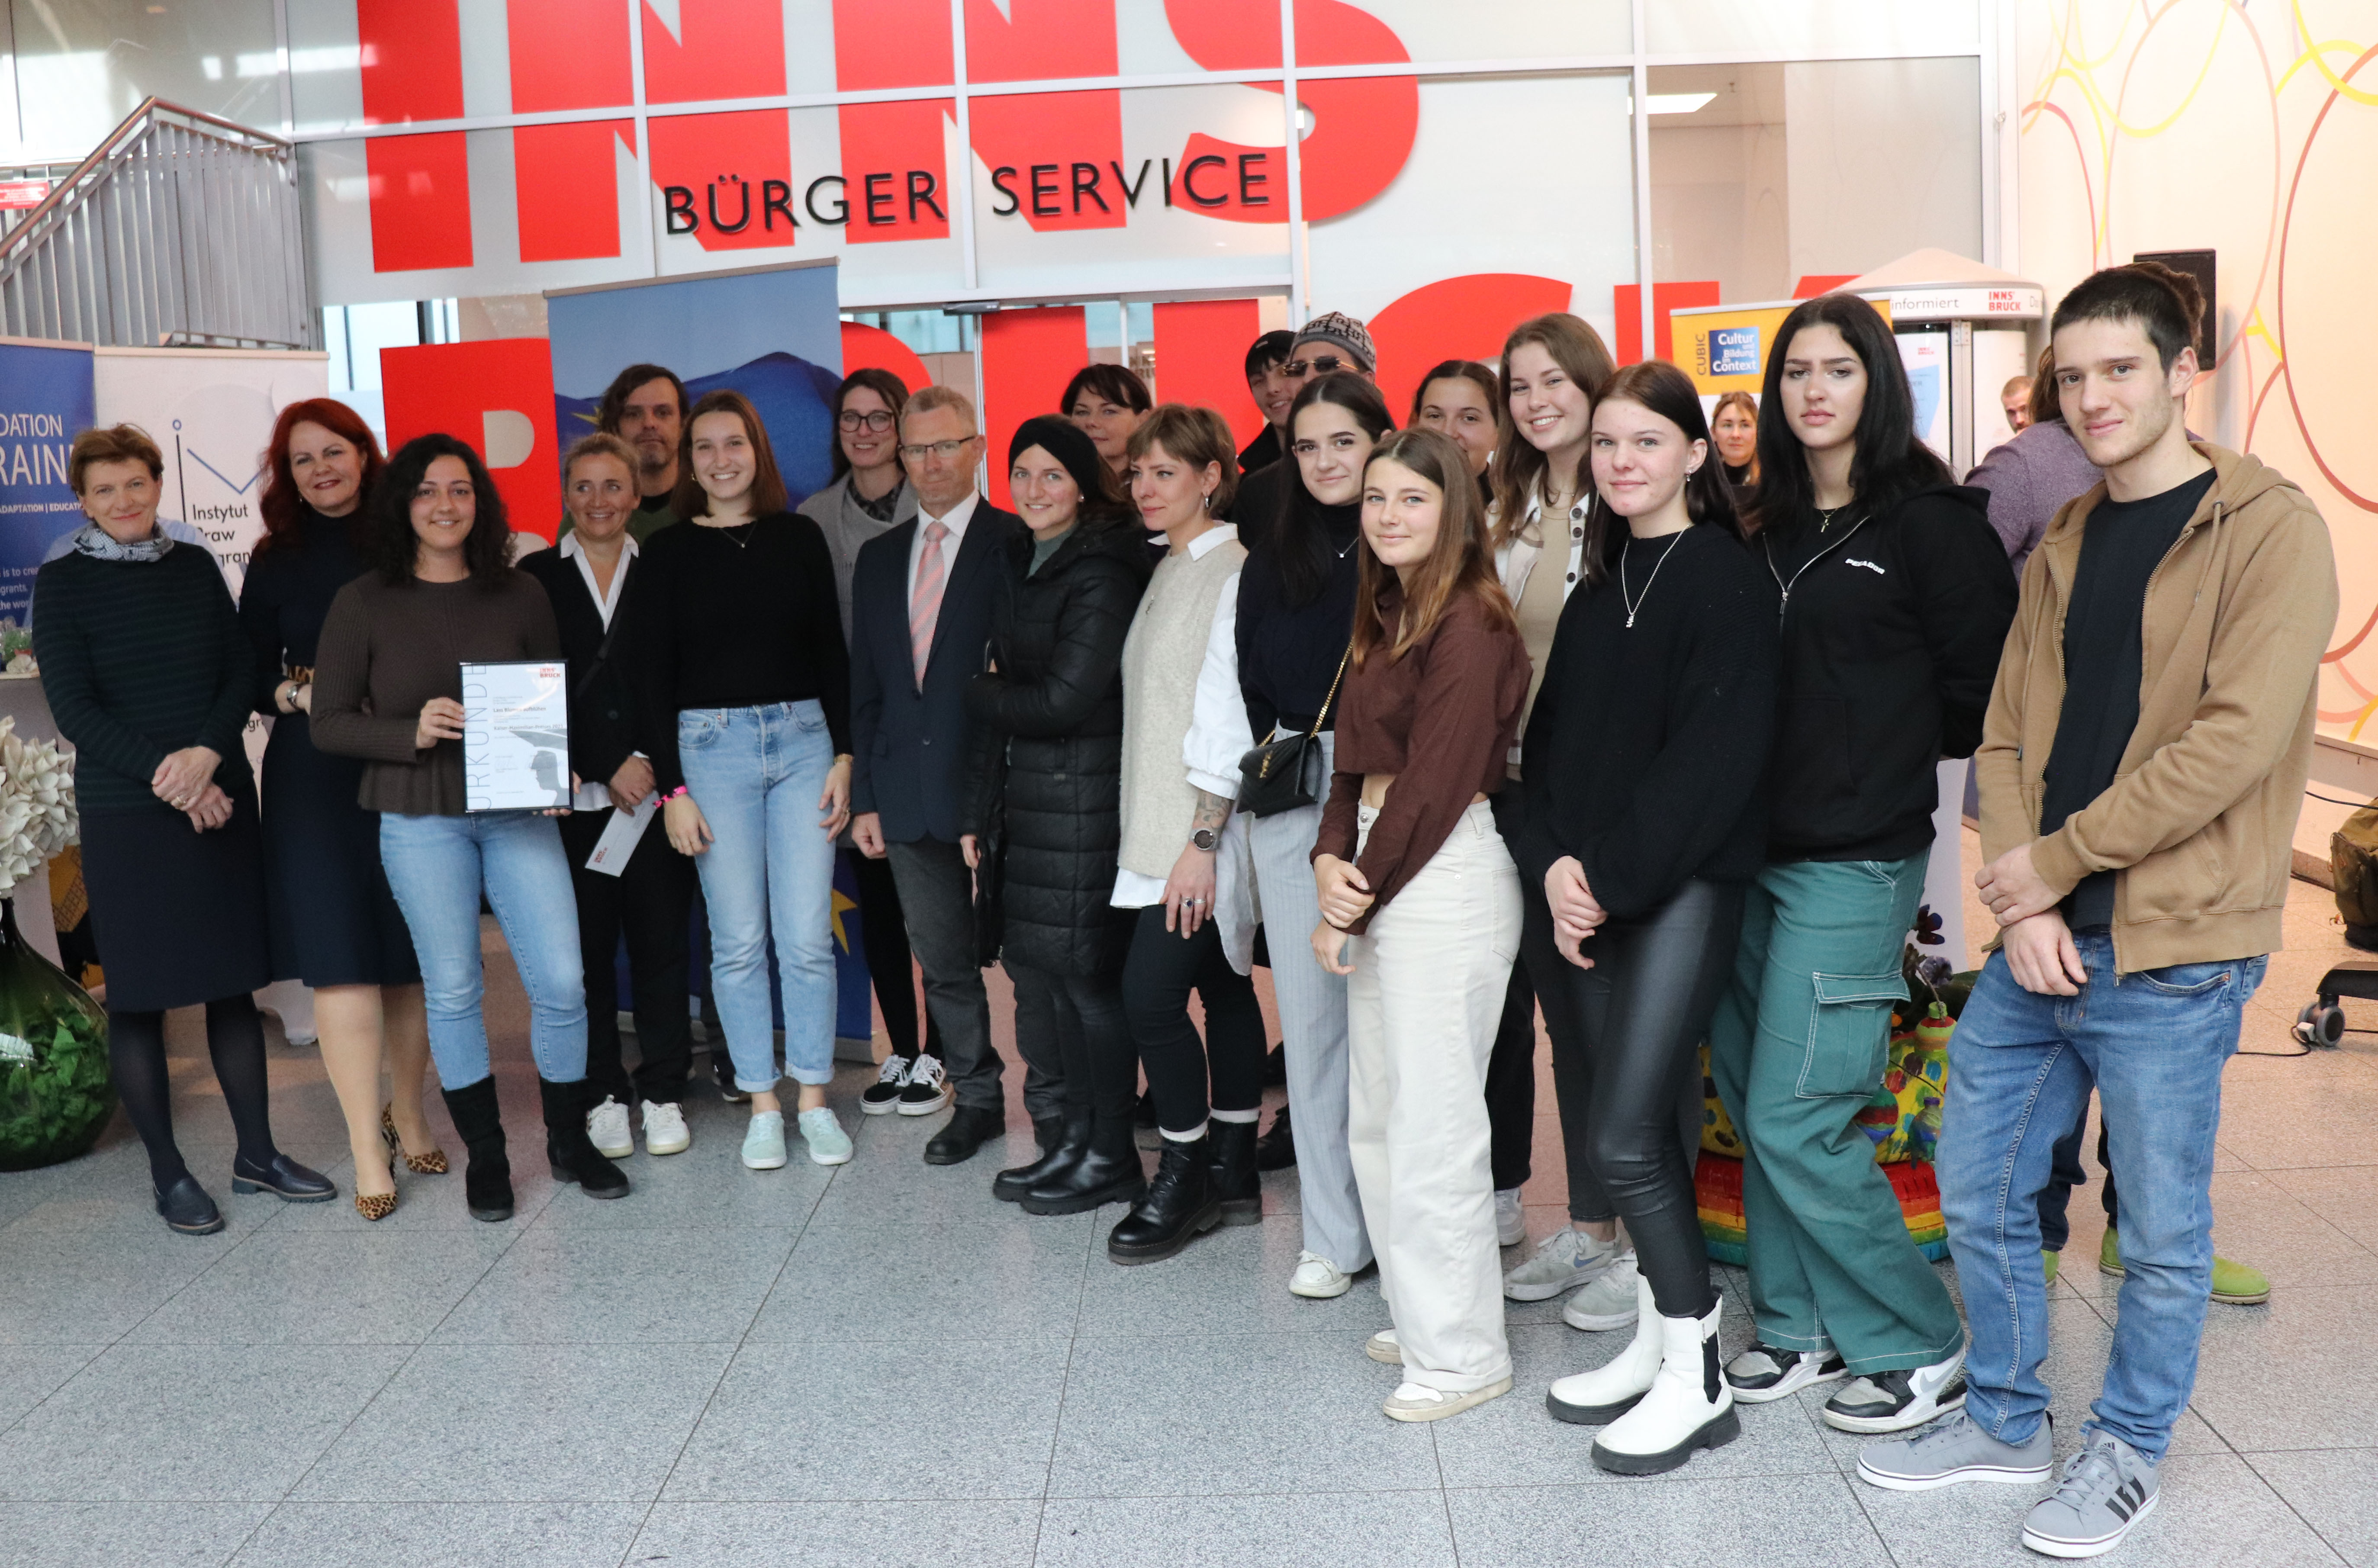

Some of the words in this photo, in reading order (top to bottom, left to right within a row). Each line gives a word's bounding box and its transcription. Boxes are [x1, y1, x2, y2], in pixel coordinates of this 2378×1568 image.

[664, 171, 947, 235] BÜRGER
[991, 153, 1269, 216] SERVICE
[1892, 297, 1959, 310] informiert
[1989, 302, 2021, 311] BRUCK
[1718, 333, 1754, 345] Cultur
[1696, 334, 1706, 375] CUBIC
[1723, 349, 1754, 358] Bildung
[1712, 360, 1756, 372] Context
[193, 503, 248, 523] Instytut
[3, 568, 10, 577] is
[12, 567, 20, 576] to
[462, 665, 492, 809] URKUNDE
